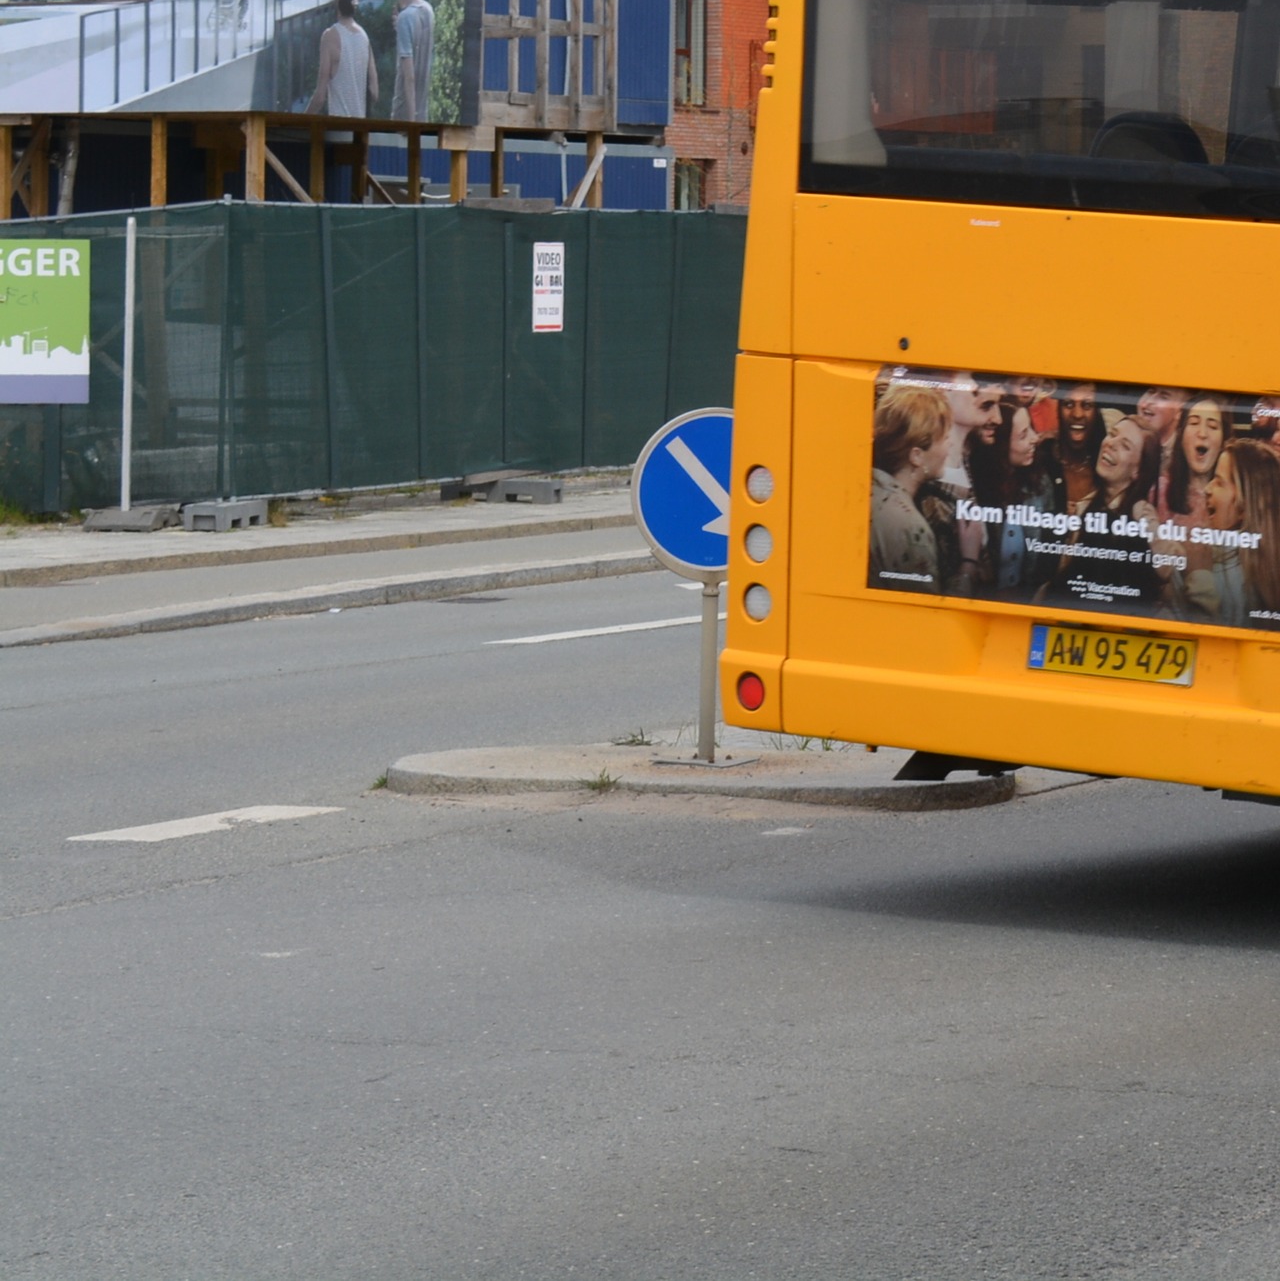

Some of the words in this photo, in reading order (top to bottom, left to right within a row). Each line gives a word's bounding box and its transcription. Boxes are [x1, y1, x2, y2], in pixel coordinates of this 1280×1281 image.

[0, 248, 80, 276] GER
[536, 252, 562, 266] VIDEO
[956, 499, 1002, 523] Kom
[1006, 505, 1082, 535] tilbage
[1084, 513, 1109, 534] til
[1111, 518, 1153, 542] det,
[1158, 520, 1187, 542] du
[1190, 527, 1262, 549] savner
[1025, 537, 1127, 562] Vaccinationerne
[1128, 552, 1144, 564] er
[1152, 555, 1187, 570] gang
[1087, 582, 1141, 597] Vaccination
[1048, 633, 1089, 666] AW
[1095, 637, 1128, 670] 95
[1136, 642, 1188, 678] 479
